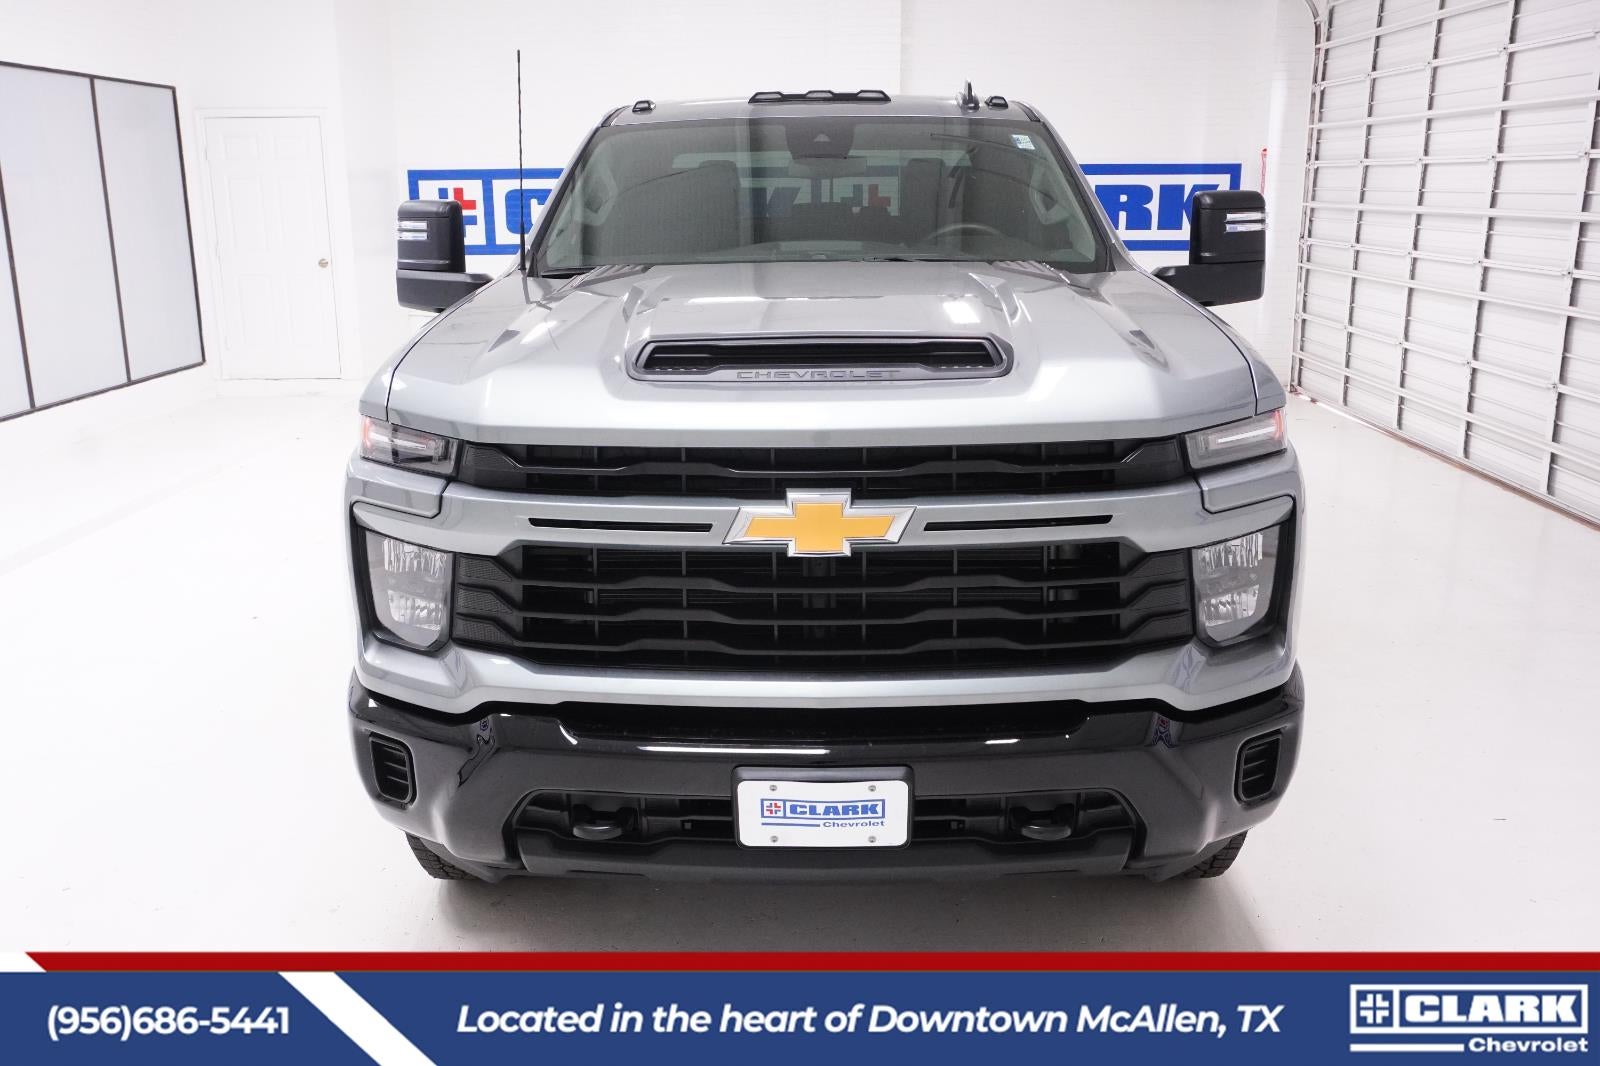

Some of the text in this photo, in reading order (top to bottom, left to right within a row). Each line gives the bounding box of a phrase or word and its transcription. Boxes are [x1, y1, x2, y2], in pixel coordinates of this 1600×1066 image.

[736, 369, 901, 380] CHEVROLET
[789, 803, 879, 816] CLARK
[822, 820, 885, 828] Chevrolet
